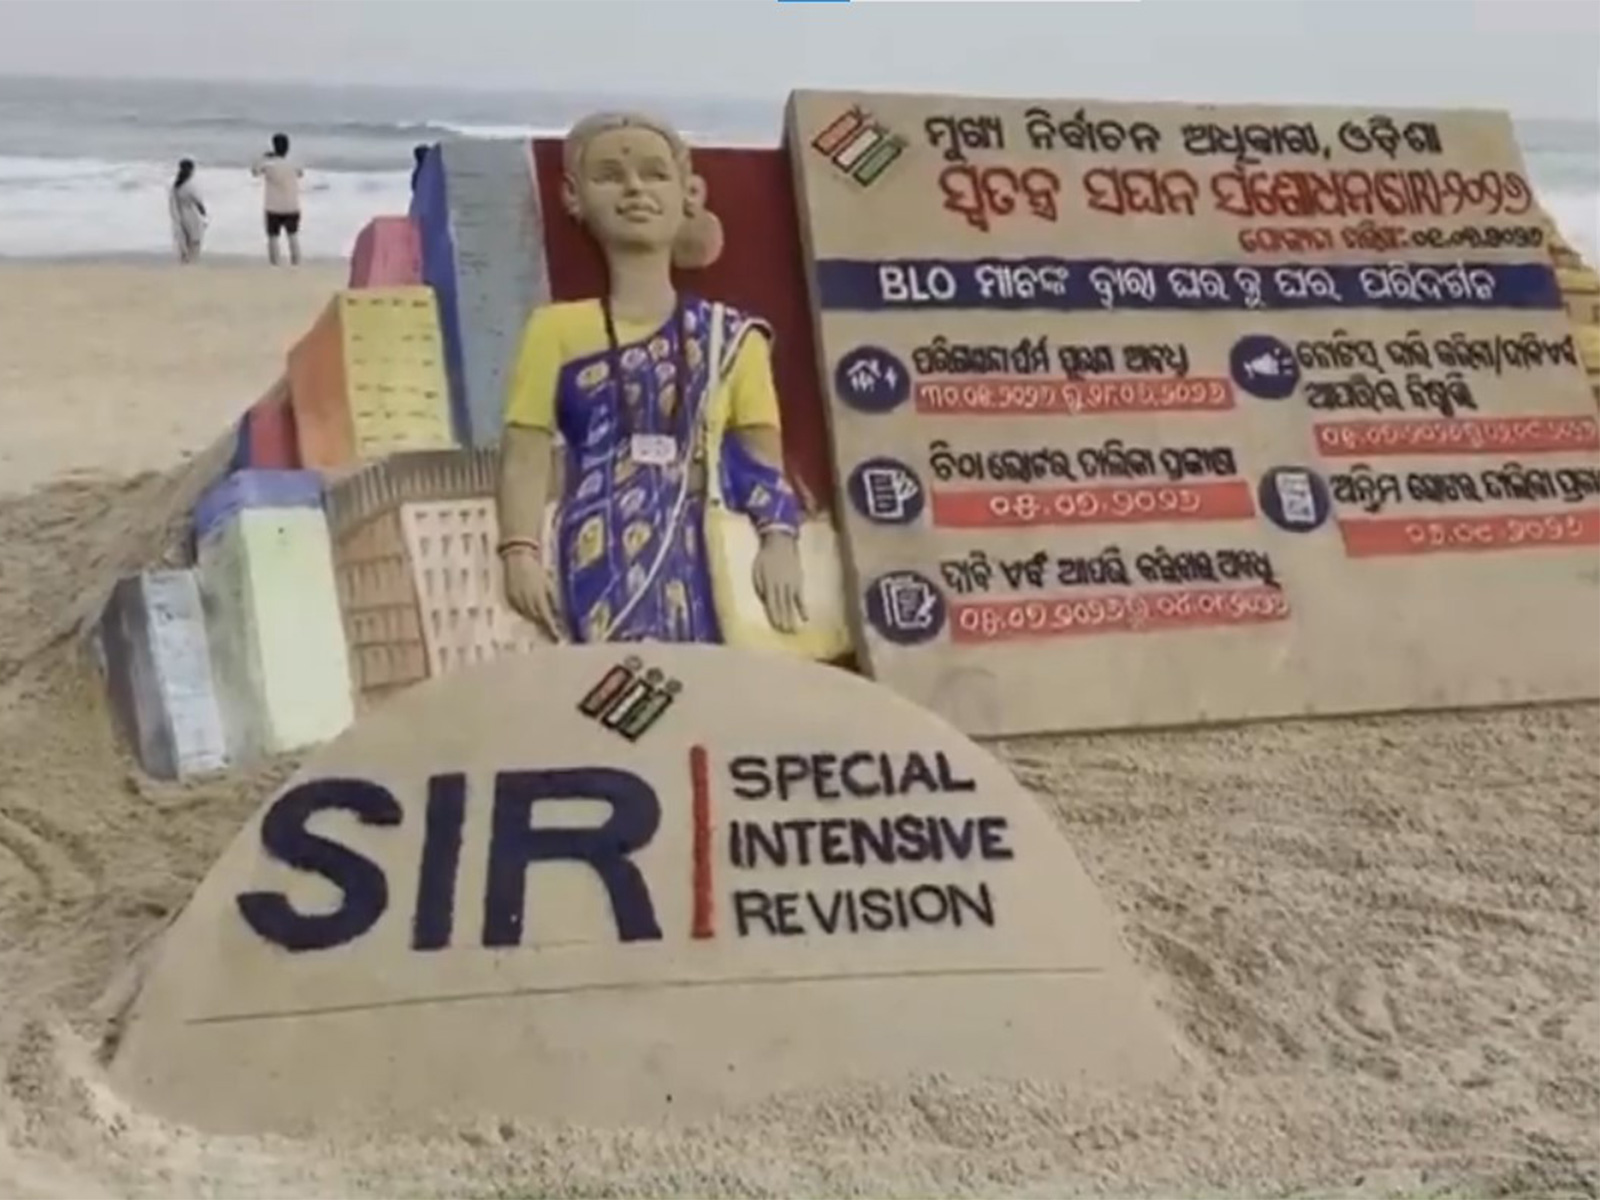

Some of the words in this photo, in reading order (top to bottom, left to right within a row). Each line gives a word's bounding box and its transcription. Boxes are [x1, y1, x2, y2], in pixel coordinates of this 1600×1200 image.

[924, 115, 1004, 161] ମୁଖ୍ୟ
[1025, 107, 1161, 153] ନିର୍ବାଚନ
[1083, 165, 1199, 216] ସଘନ
[879, 265, 957, 302] BLO
[729, 751, 976, 799] SPECIAL
[235, 765, 664, 952] SIR
[728, 816, 1015, 868] INTENSIVE
[735, 883, 996, 937] REVISION
